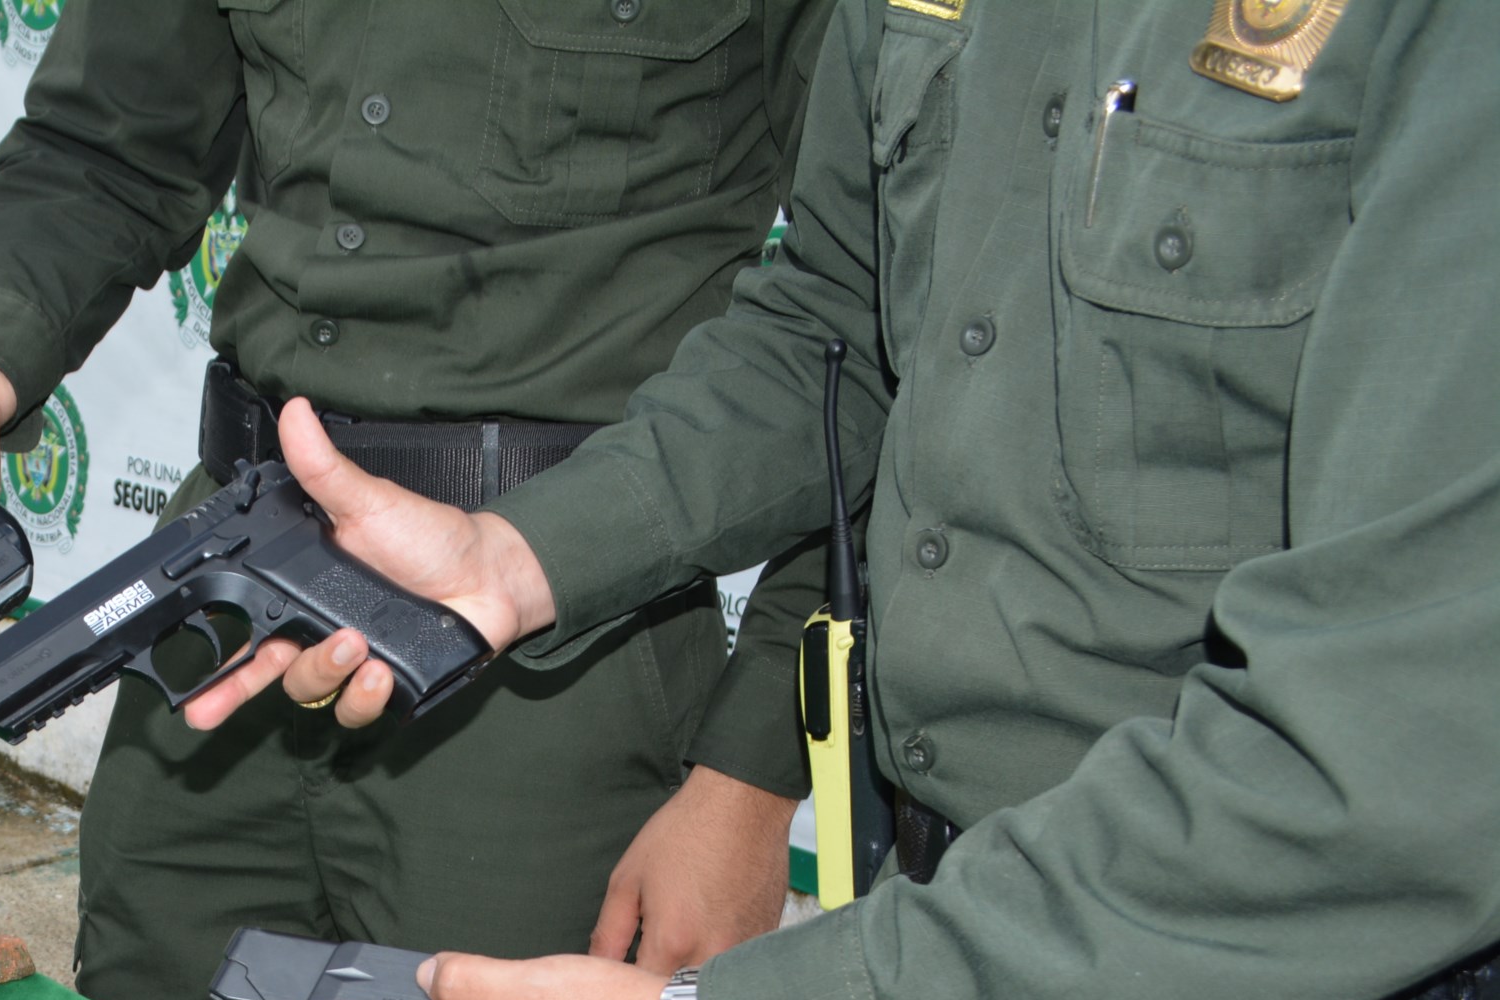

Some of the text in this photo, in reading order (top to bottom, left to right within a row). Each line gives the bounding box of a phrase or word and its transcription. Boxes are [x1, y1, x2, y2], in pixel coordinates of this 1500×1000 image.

[193, 321, 209, 341] DIO
[52, 399, 76, 477] COLOMBIA
[127, 456, 182, 484] POR UNA
[114, 478, 168, 517] SEGUR
[83, 585, 138, 626] SWISS
[105, 590, 153, 627] ARMS
